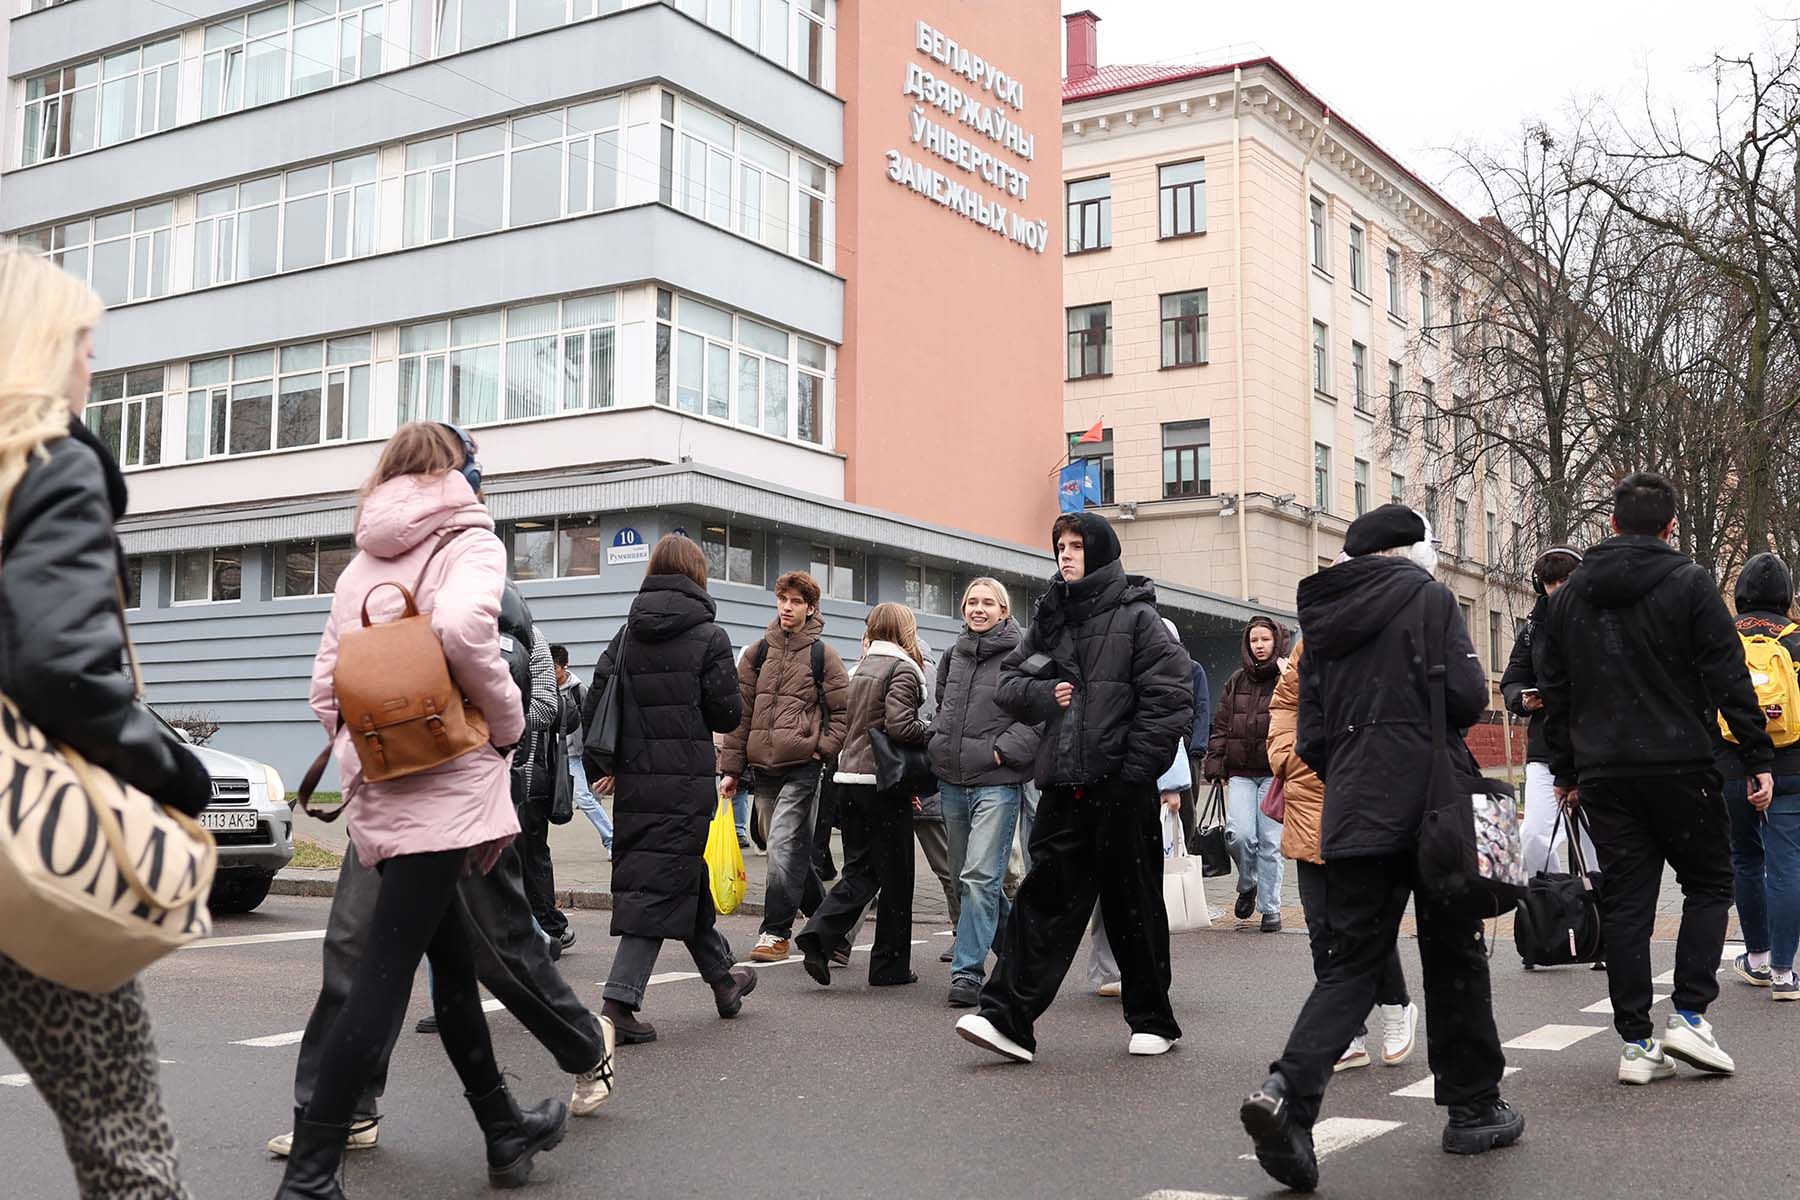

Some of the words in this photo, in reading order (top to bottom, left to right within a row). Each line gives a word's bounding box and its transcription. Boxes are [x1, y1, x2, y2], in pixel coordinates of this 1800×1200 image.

[903, 62, 1035, 161] ДЗЯРЖАЎНЫ
[916, 20, 1024, 110] БЕЛАРУСКІ
[911, 105, 1030, 201] ЎНІВЕРСІТЭТ
[886, 150, 1008, 235] ЗАМЕЖНЫХ
[1010, 214, 1049, 254] МОЎ
[620, 530, 635, 544] 10
[200, 814, 226, 828] 3113
[228, 813, 256, 828] AK-5
